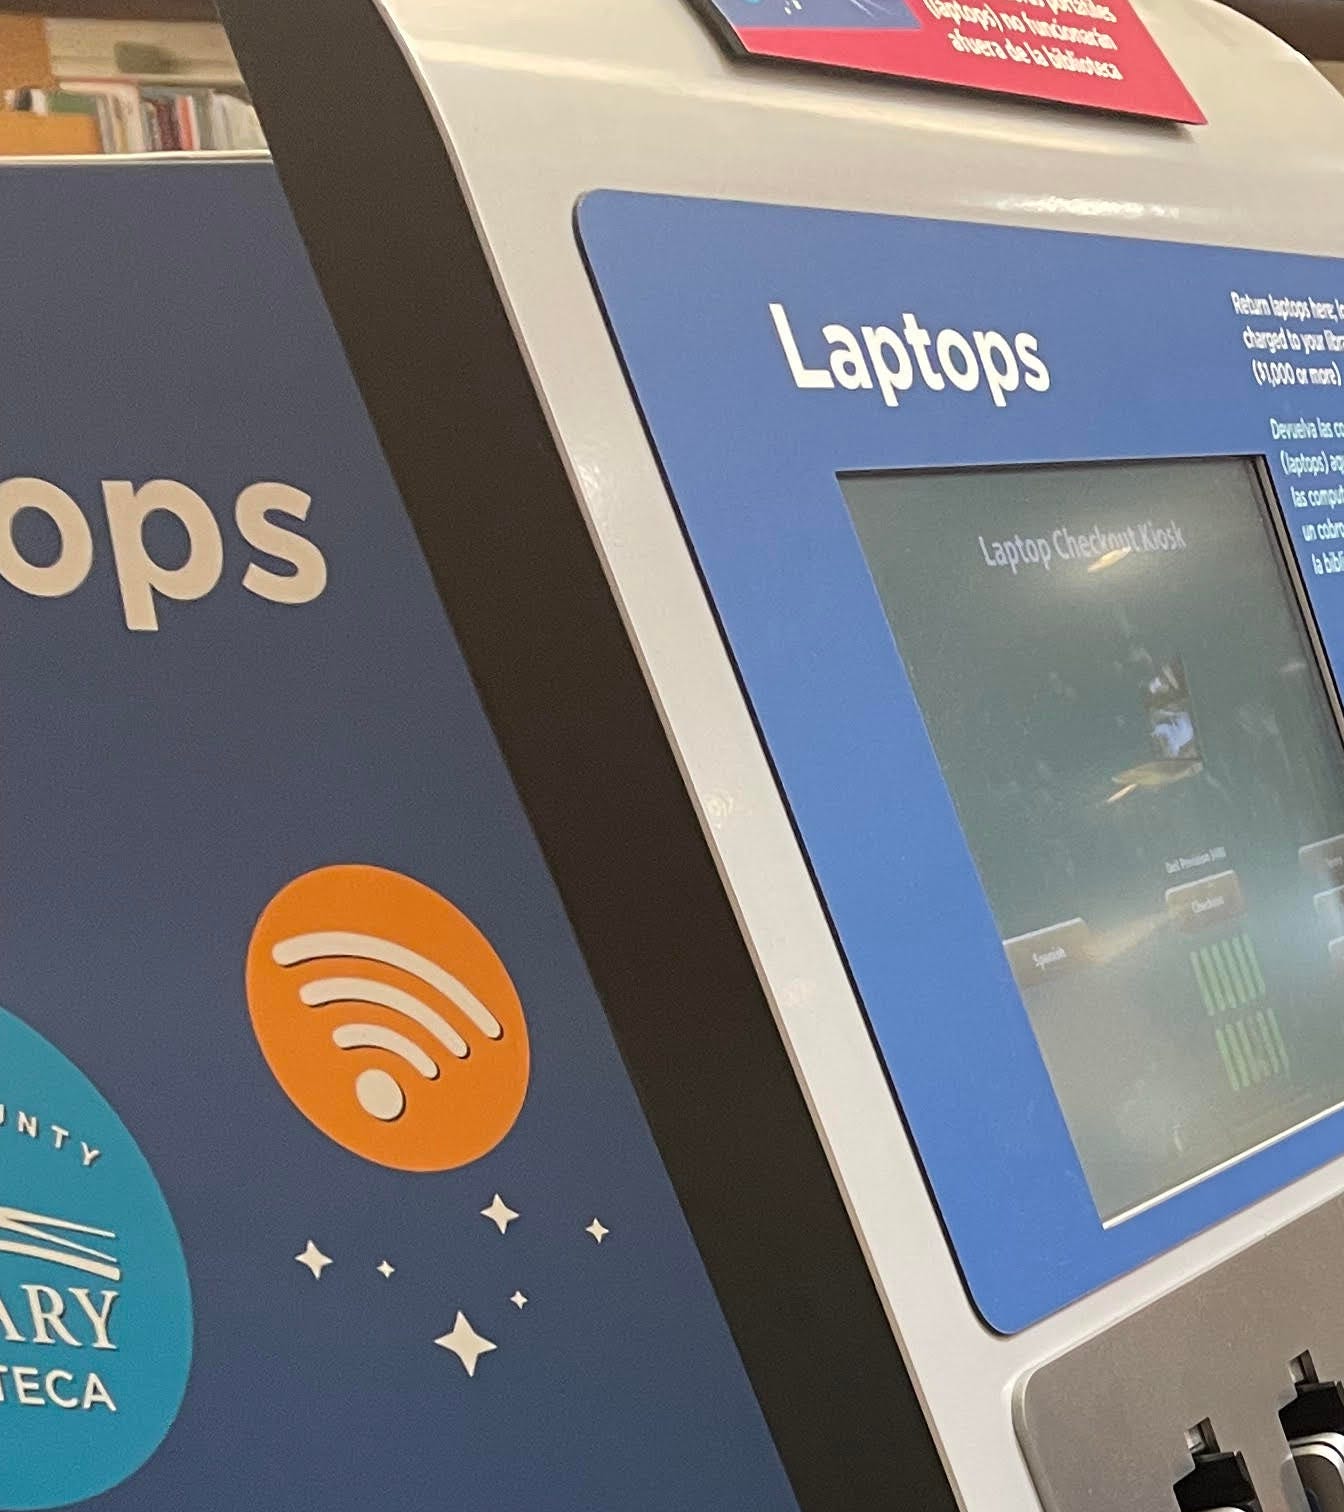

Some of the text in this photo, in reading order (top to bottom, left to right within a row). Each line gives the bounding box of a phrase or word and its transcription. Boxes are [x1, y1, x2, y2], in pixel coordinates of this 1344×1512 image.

[1001, 13, 1025, 32] no
[948, 29, 1123, 80] afuera de la biblioteca
[1231, 291, 1271, 315] Return
[1269, 294, 1310, 321] laptops
[1243, 327, 1287, 353] charged
[1286, 329, 1300, 350] to
[1300, 332, 1325, 354] your
[768, 302, 1050, 407] Laptops
[1296, 369, 1308, 385] or
[1309, 361, 1342, 386] more)
[1270, 418, 1317, 439] Devuelva
[1317, 417, 1333, 438] las
[1280, 450, 1329, 477] (laptops)
[1291, 486, 1308, 507] las
[1302, 524, 1316, 541] un
[0, 477, 327, 631] ops
[979, 520, 1186, 575] Laptop Checkout Kiosk
[1312, 554, 1323, 574] la
[0, 1104, 100, 1166] NTY
